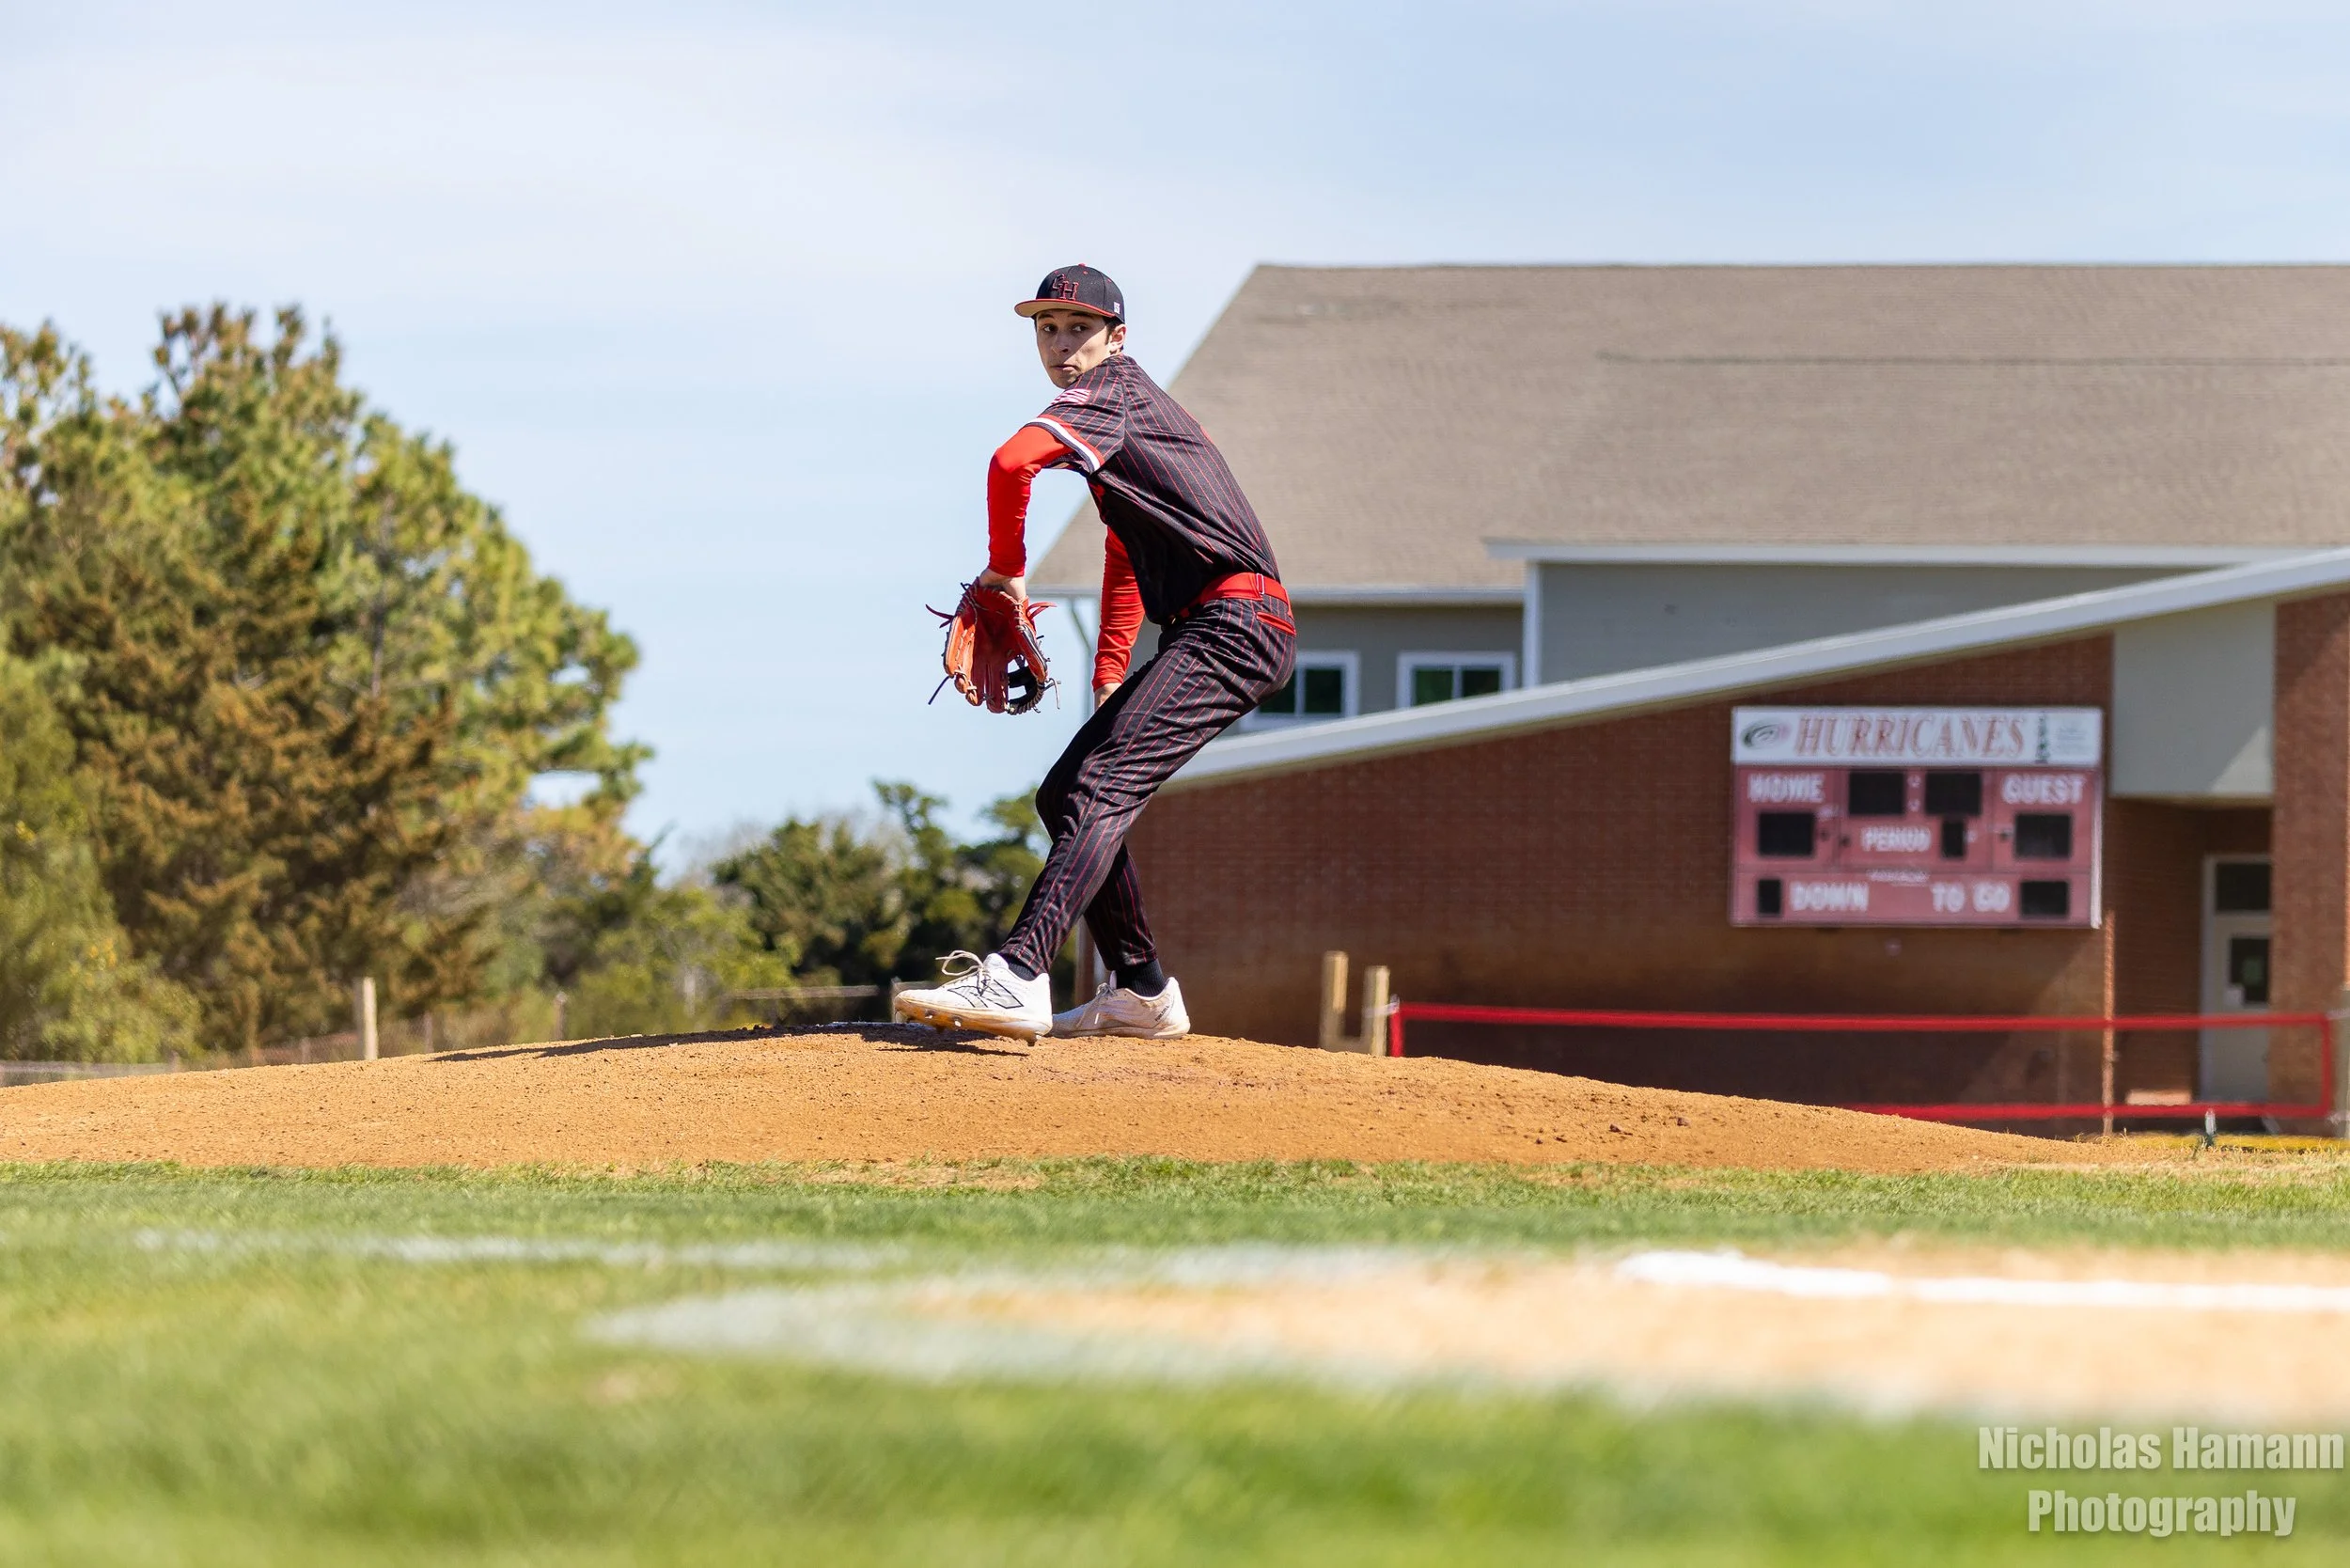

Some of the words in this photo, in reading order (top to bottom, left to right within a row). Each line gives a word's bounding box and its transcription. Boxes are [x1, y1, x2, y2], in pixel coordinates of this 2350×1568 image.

[1794, 713, 2026, 758] HURRICANES
[1748, 774, 1825, 803] HOME
[2003, 775, 2085, 805] GUEST
[1790, 882, 1870, 912] DOWN
[1932, 883, 1966, 912] TO
[1974, 883, 2012, 912] GO
